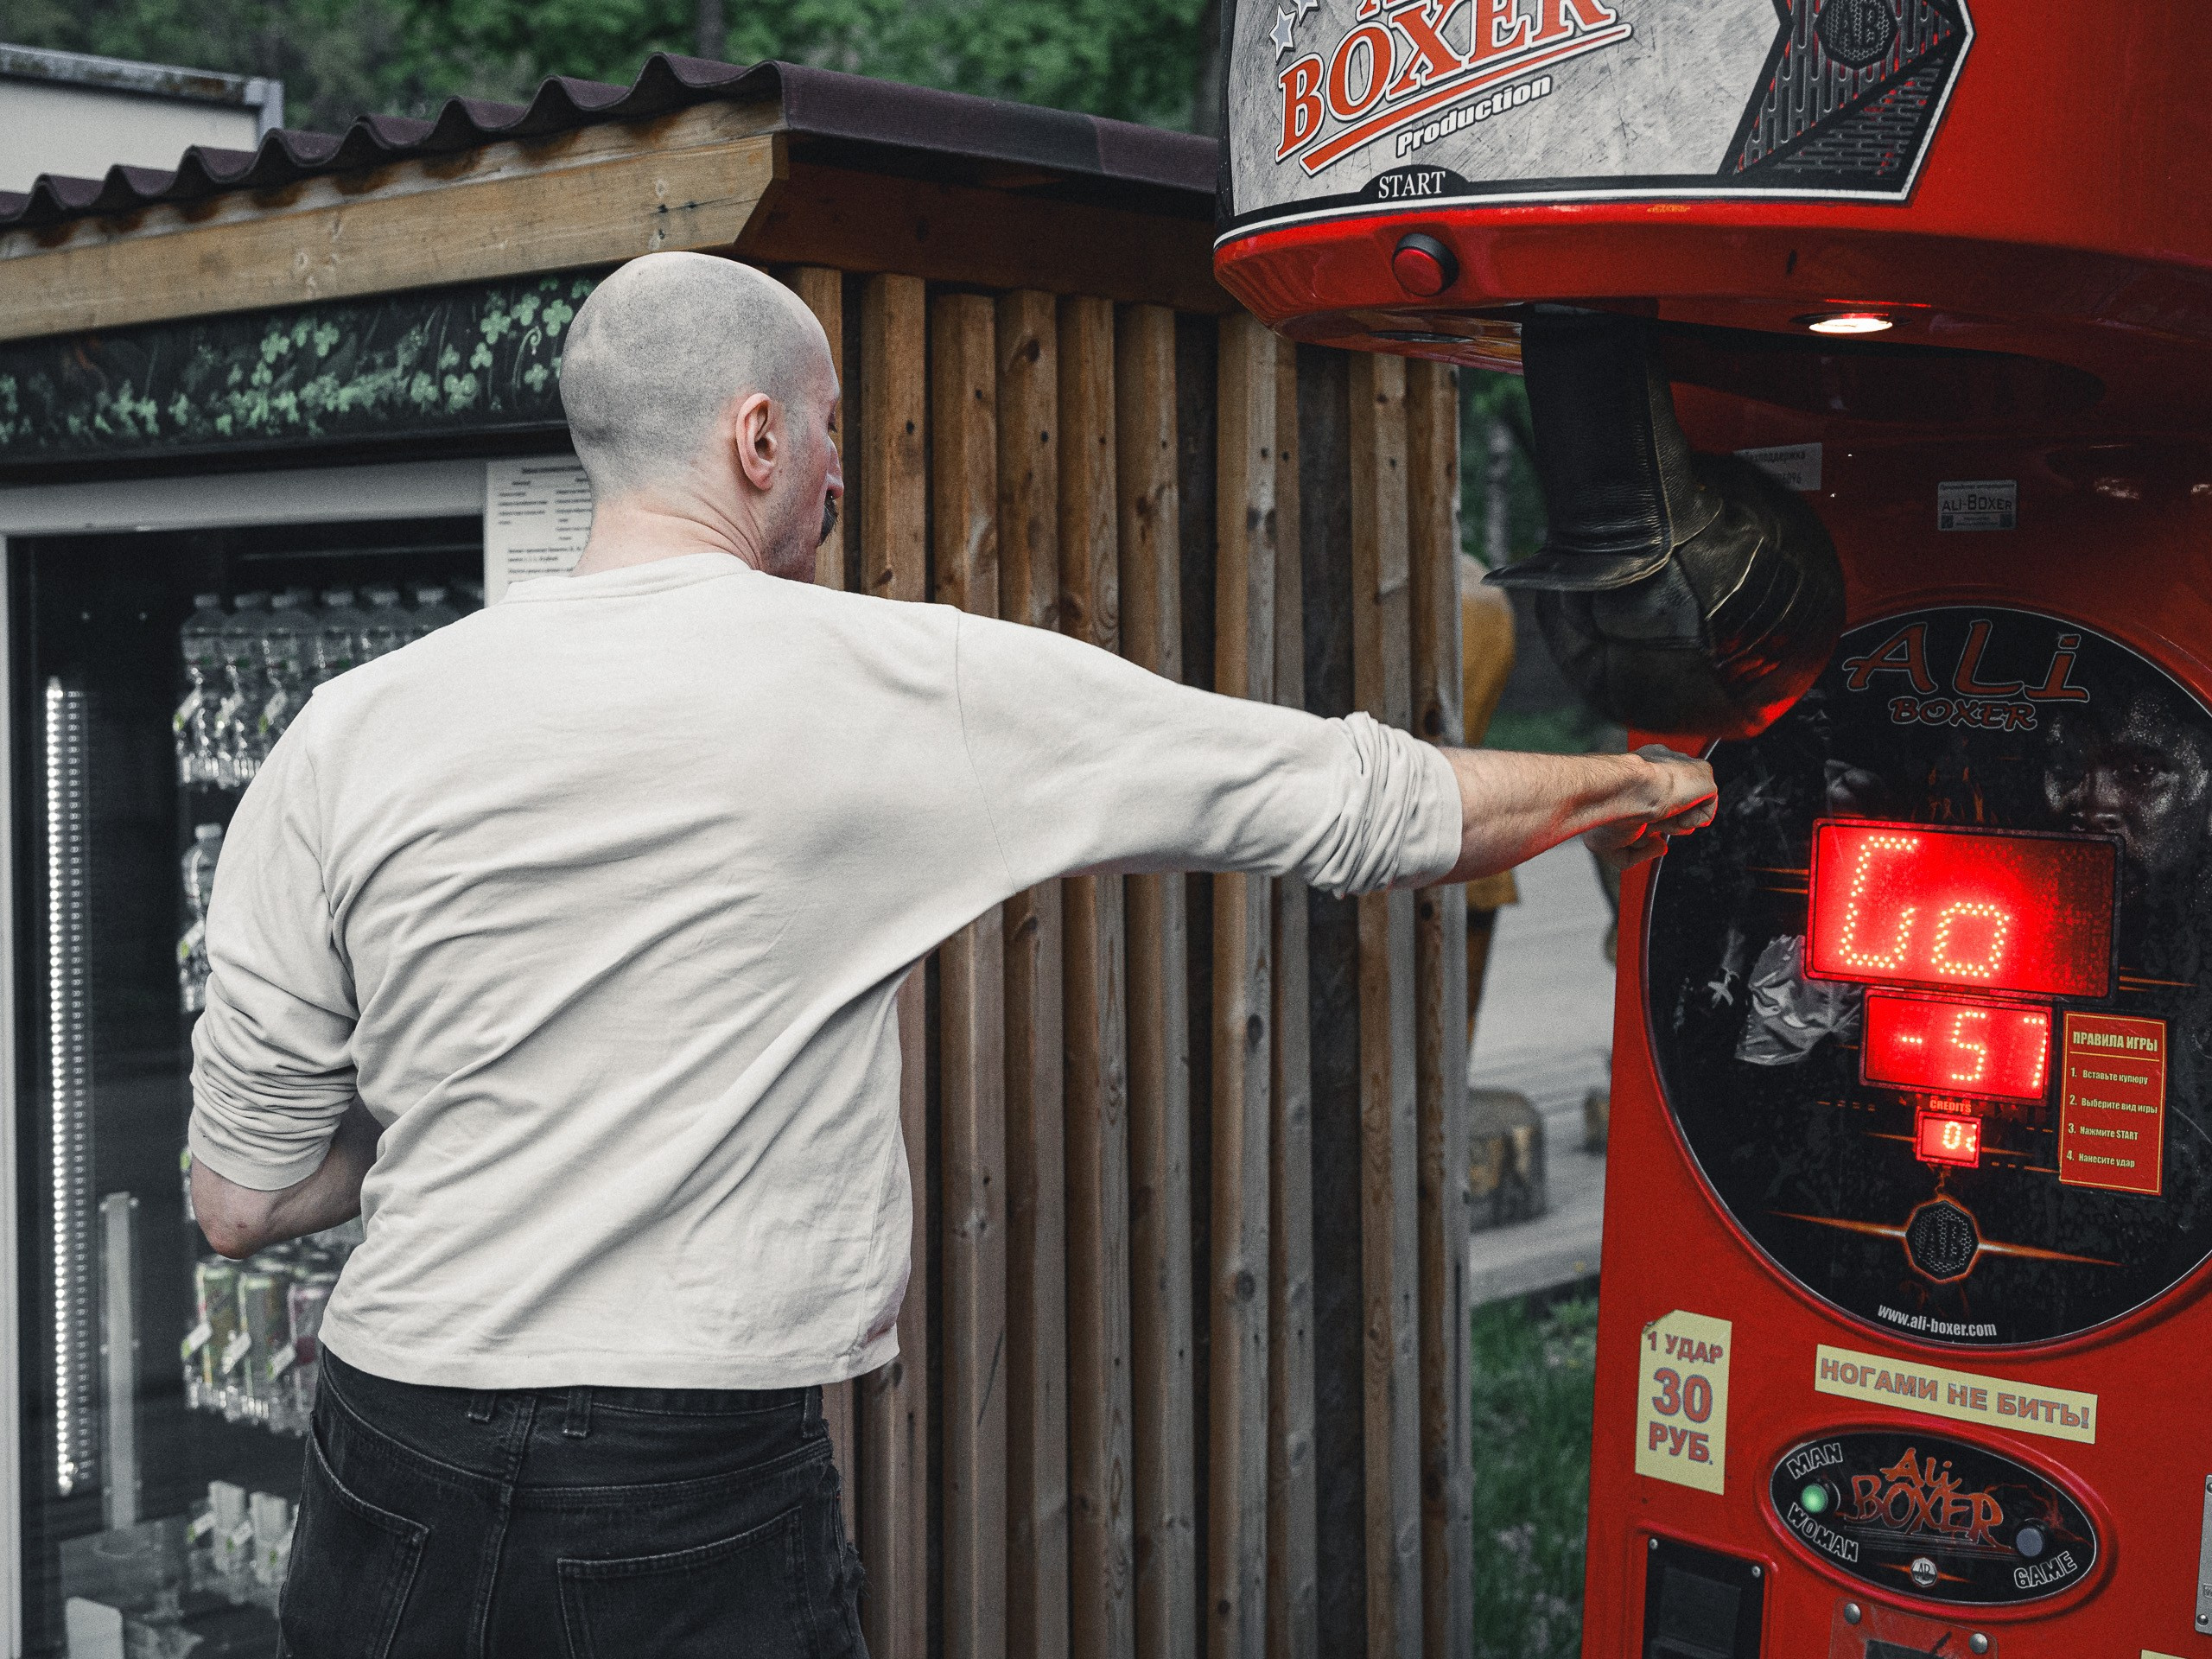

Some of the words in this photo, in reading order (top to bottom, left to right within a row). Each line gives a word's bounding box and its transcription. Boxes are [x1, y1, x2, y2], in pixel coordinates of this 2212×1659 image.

[1396, 75, 1552, 158] Production
[1378, 171, 1446, 200] START
[1888, 696, 2037, 731] BOXER
[2073, 1031, 2124, 1048] ПРАВИЛА
[2126, 1036, 2158, 1052] ИГРЫ
[2070, 1067, 2077, 1077] 1.
[2082, 1070, 2118, 1081] Вставьте
[2119, 1074, 2148, 1085] купюру
[1929, 1099, 1972, 1113] CREDITS
[2069, 1094, 2077, 1106] 2.
[2082, 1097, 2120, 1109] Выберите
[2121, 1103, 2138, 1112] вид
[2138, 1105, 2158, 1114] игры
[2068, 1122, 2076, 1134] 3.
[2080, 1126, 2115, 1137] Нажмите
[2116, 1130, 2139, 1141] START
[2066, 1150, 2075, 1160] 4.
[2078, 1153, 2115, 1165] Нанесите
[2116, 1160, 2136, 1168] удар
[1878, 1305, 1998, 1337] www.ali-boxer.com
[1648, 1331, 1658, 1351] 1
[1665, 1333, 1724, 1364] УДАР
[1651, 1367, 1713, 1423] 30
[1821, 1357, 1938, 1401] НОГАМИ
[1947, 1382, 1987, 1411] НЕ
[1997, 1392, 2090, 1428] БИТЬ!
[1649, 1421, 1713, 1465] РУБ.
[1786, 1442, 1843, 1479] MAN
[1845, 1474, 2012, 1549] BOXER
[1787, 1503, 1859, 1562] WOMAN
[2014, 1551, 2077, 1588] GAME
